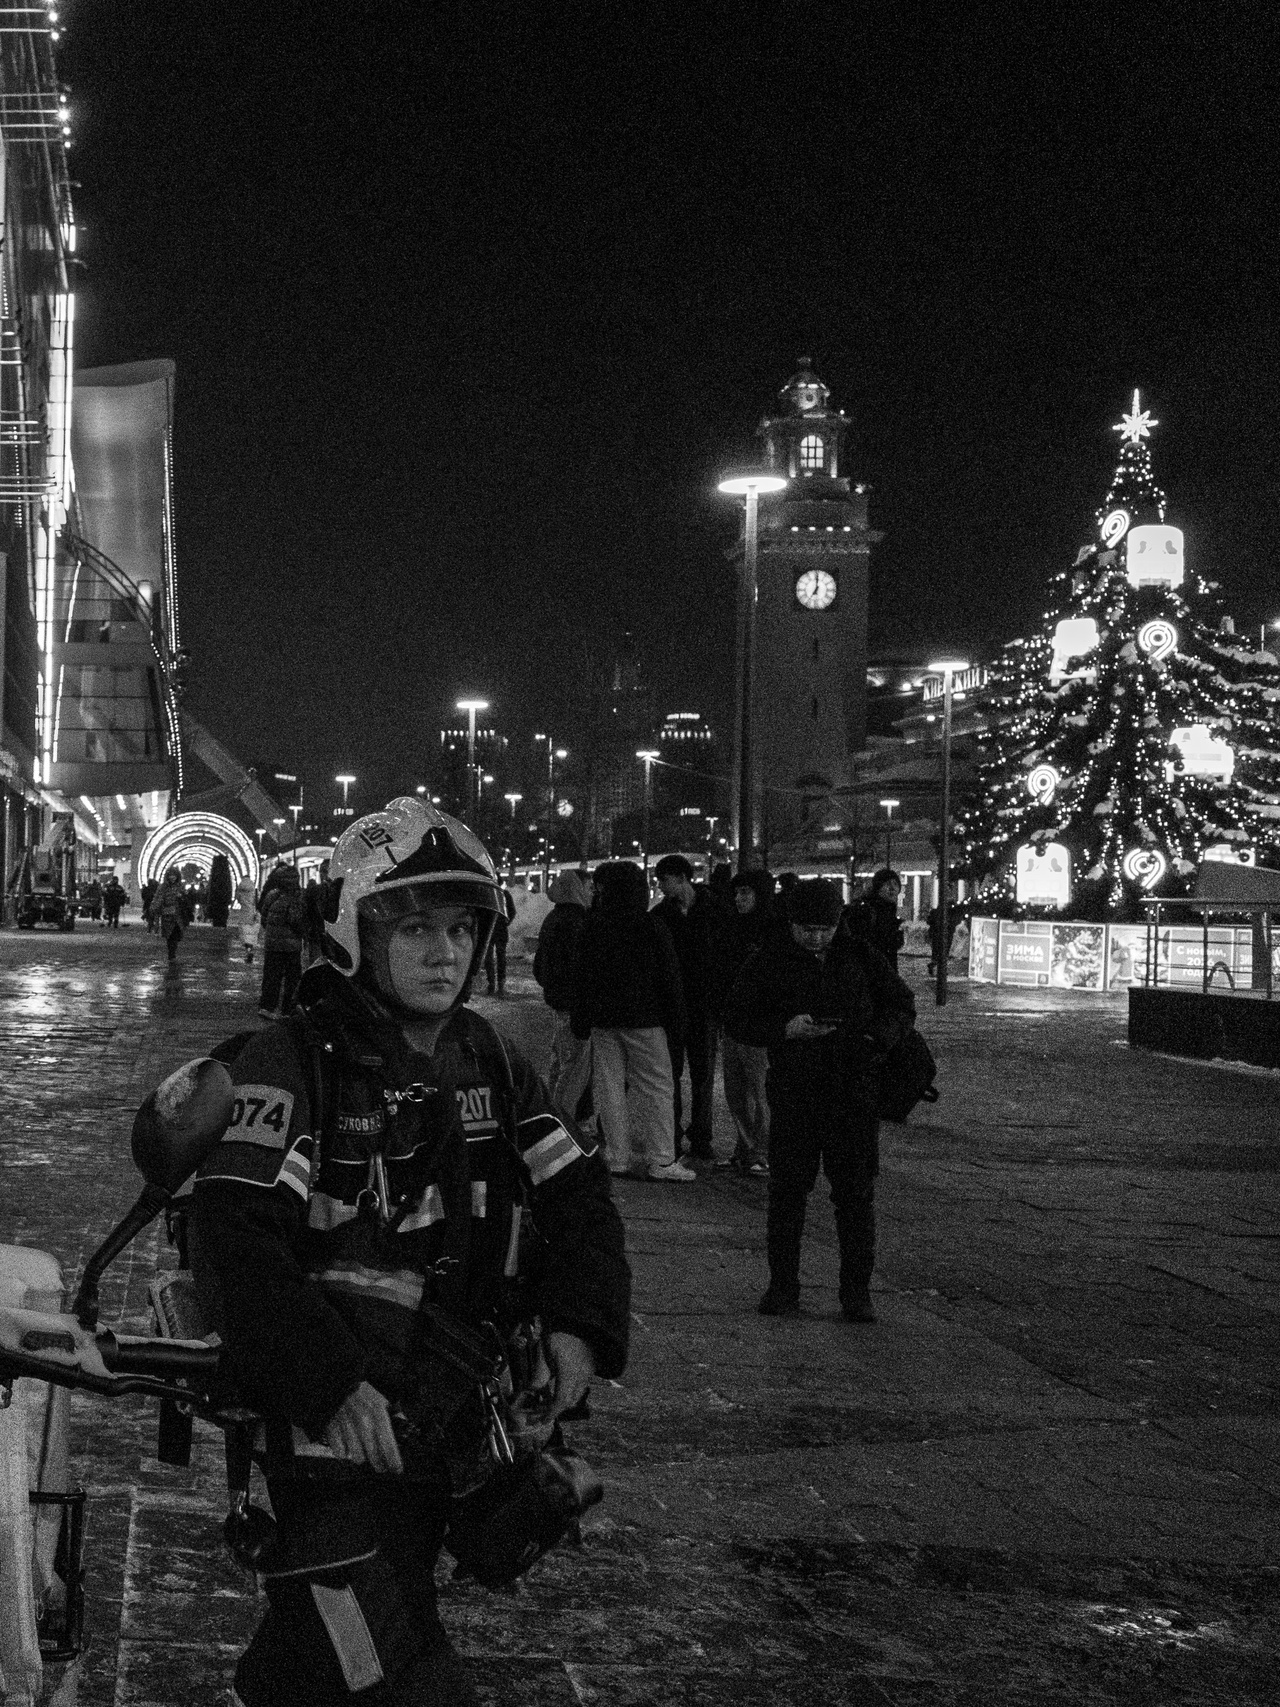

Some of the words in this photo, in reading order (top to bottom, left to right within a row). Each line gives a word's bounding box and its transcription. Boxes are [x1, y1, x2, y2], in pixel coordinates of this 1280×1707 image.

[923, 662, 980, 701] КИЕСКИЙ
[1006, 944, 1044, 956] ЗИМА
[1186, 957, 1216, 966] 206
[455, 1087, 493, 1122] 207
